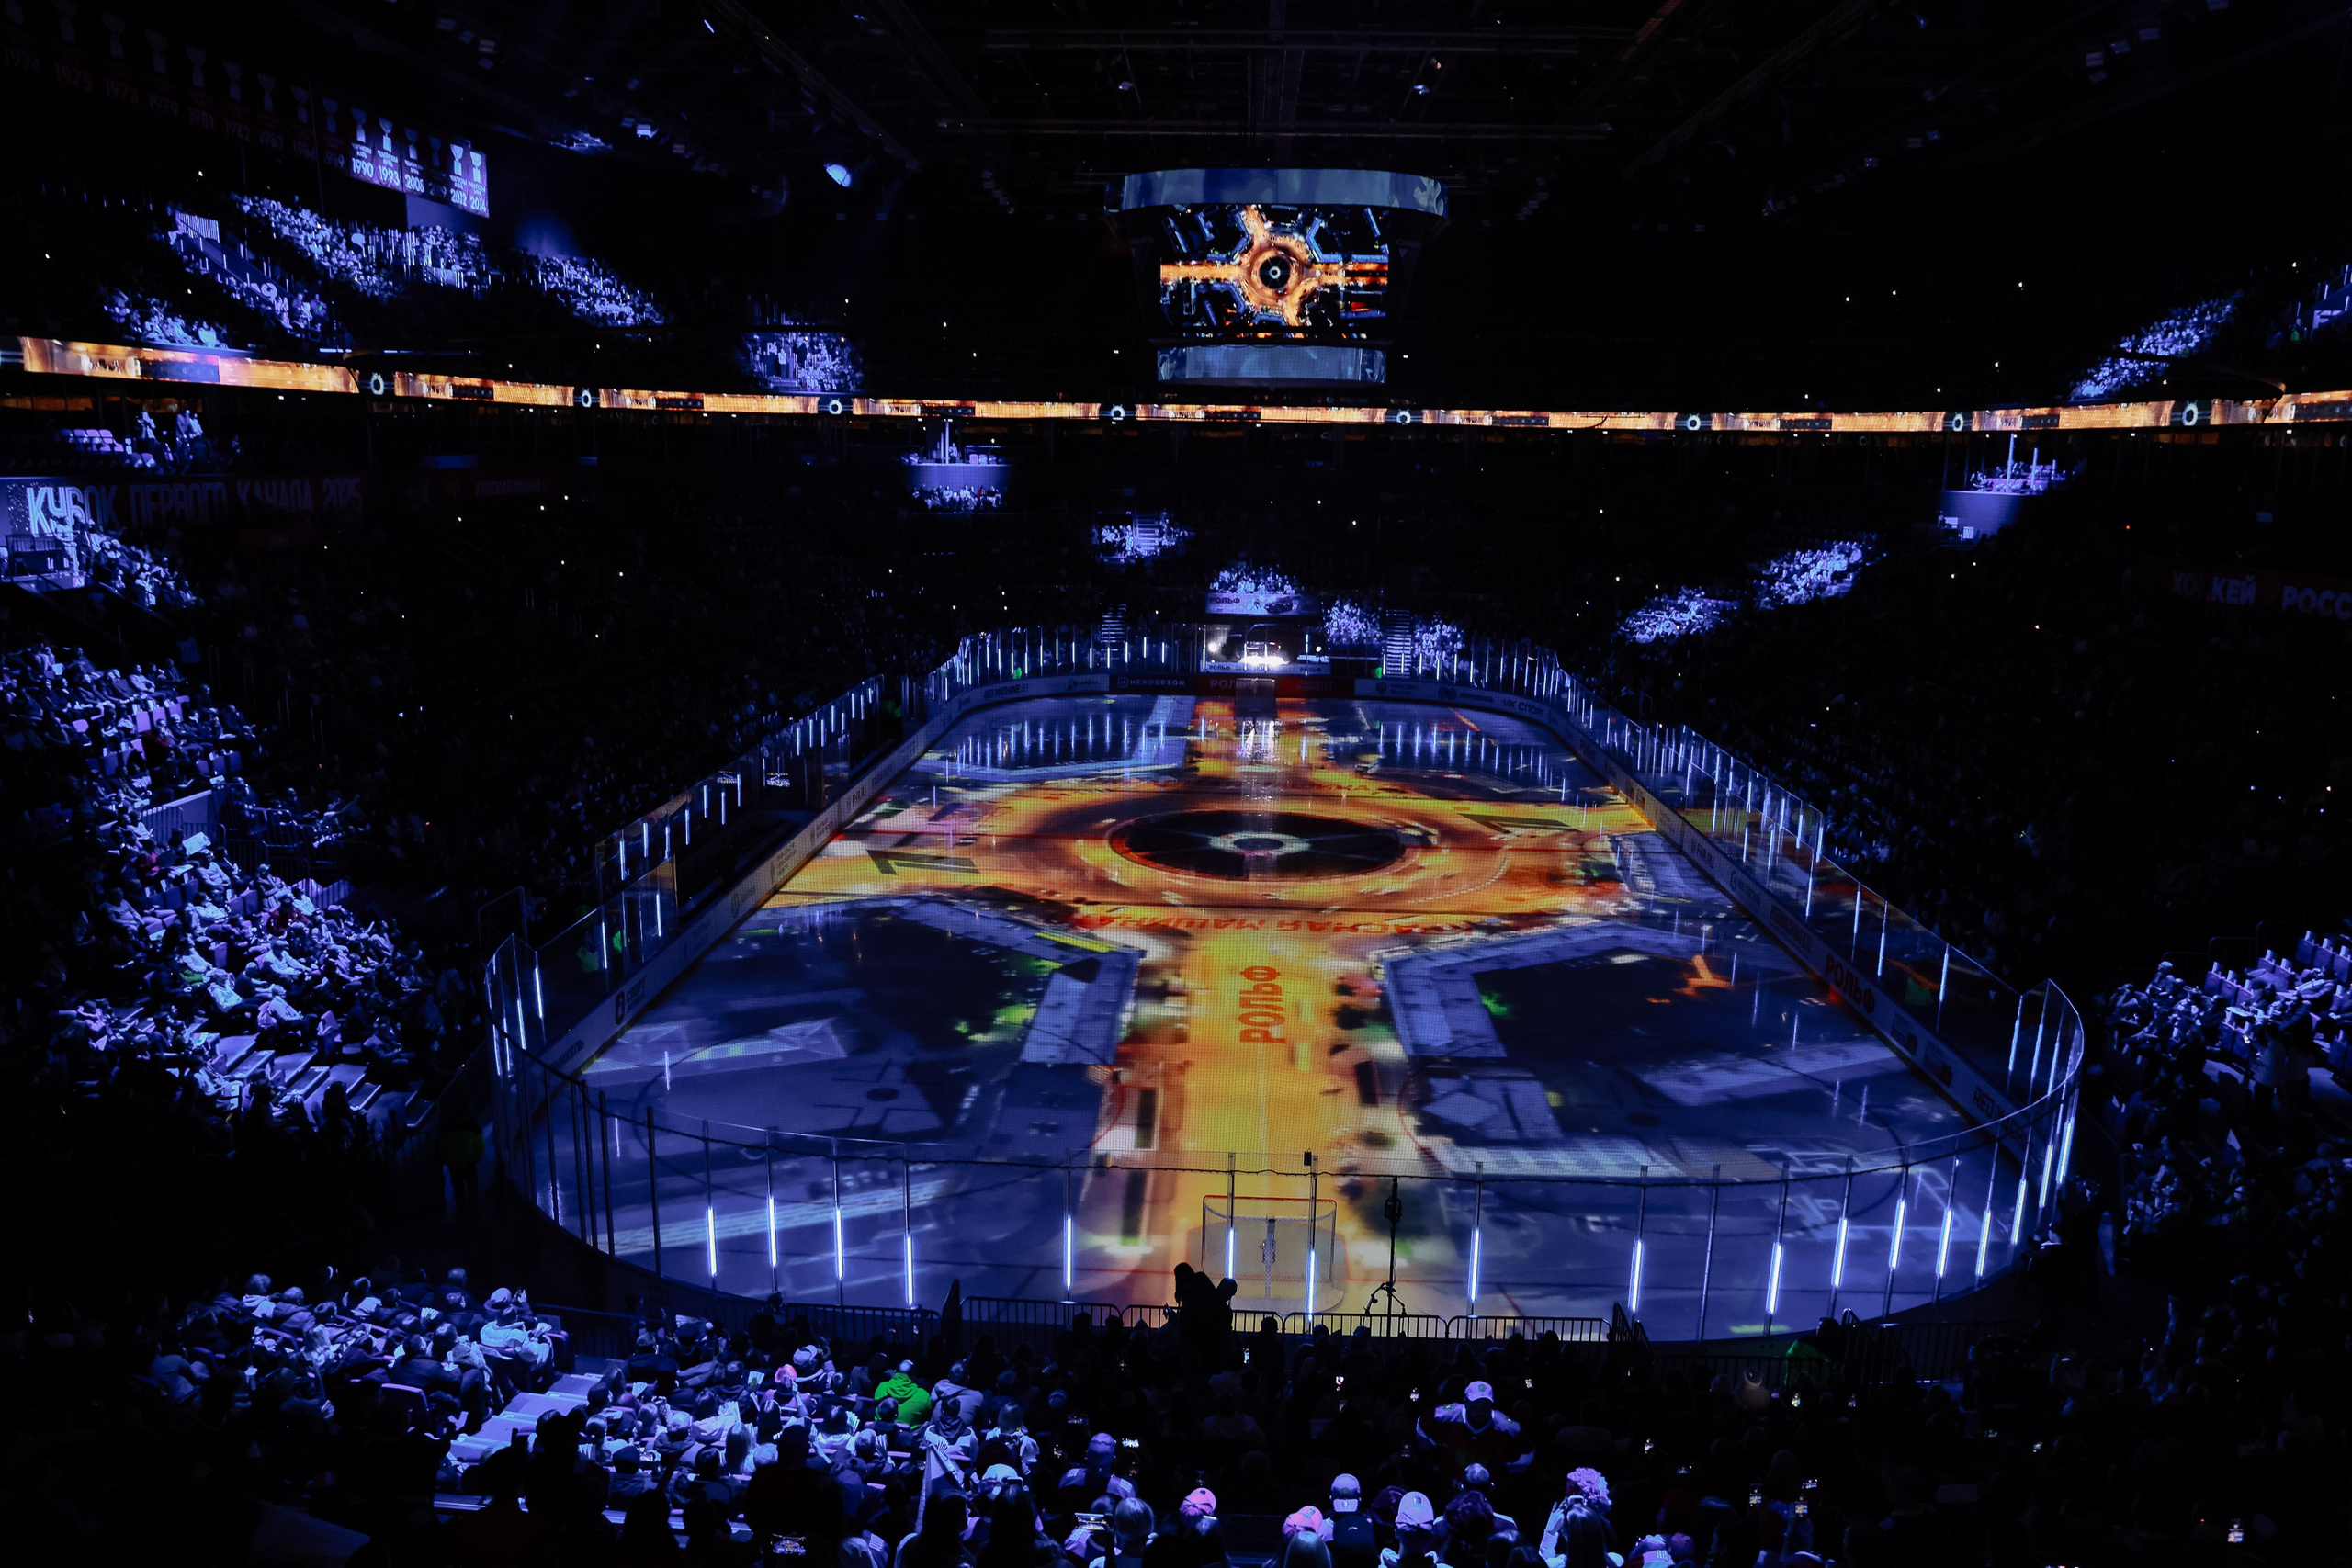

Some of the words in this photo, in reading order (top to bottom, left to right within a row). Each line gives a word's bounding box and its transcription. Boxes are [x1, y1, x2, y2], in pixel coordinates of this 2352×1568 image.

[352, 157, 374, 178] 1990
[379, 165, 401, 186] 1993
[26, 484, 120, 537] КУБОК
[1209, 596, 1240, 604] РОЛЬФ
[2172, 570, 2257, 606] ХОКЕЙ
[1502, 698, 1515, 708] VK
[1825, 953, 1875, 1013] РОЛЬФ
[1238, 965, 1286, 1043] РОЛЬФ
